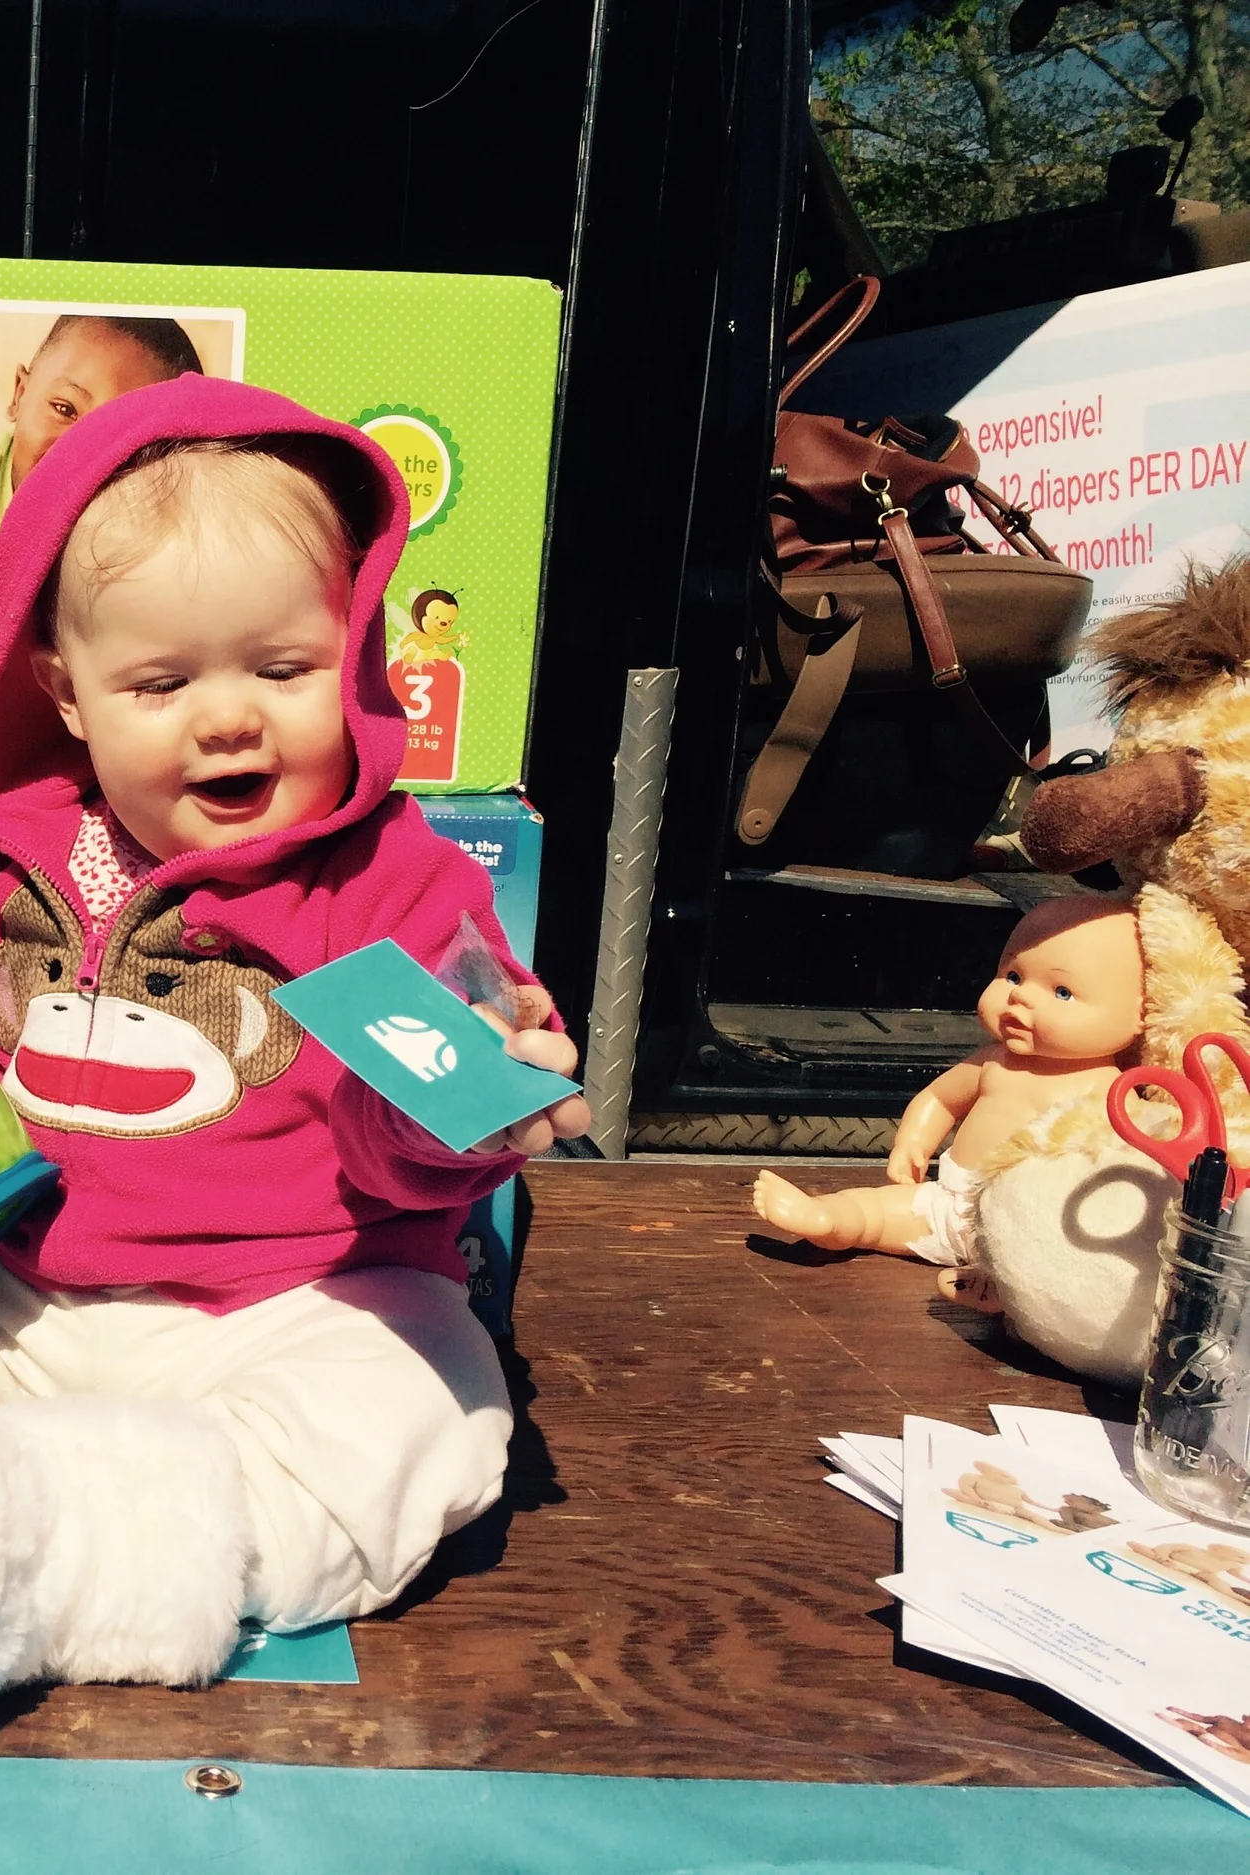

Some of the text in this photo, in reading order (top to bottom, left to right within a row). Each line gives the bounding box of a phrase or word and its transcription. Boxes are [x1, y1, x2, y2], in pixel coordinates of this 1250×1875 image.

[978, 394, 1102, 458] expensive!
[404, 454, 438, 473] the
[1031, 469, 1119, 515] diapers
[1130, 450, 1181, 497] PER
[1192, 440, 1247, 490] DAY
[1067, 522, 1154, 571] month!
[1101, 594, 1132, 605] easily
[404, 674, 433, 720] 3
[430, 724, 443, 735] lb
[423, 738, 439, 751] kg
[475, 840, 503, 853] the
[1182, 1604, 1250, 1642] diap
